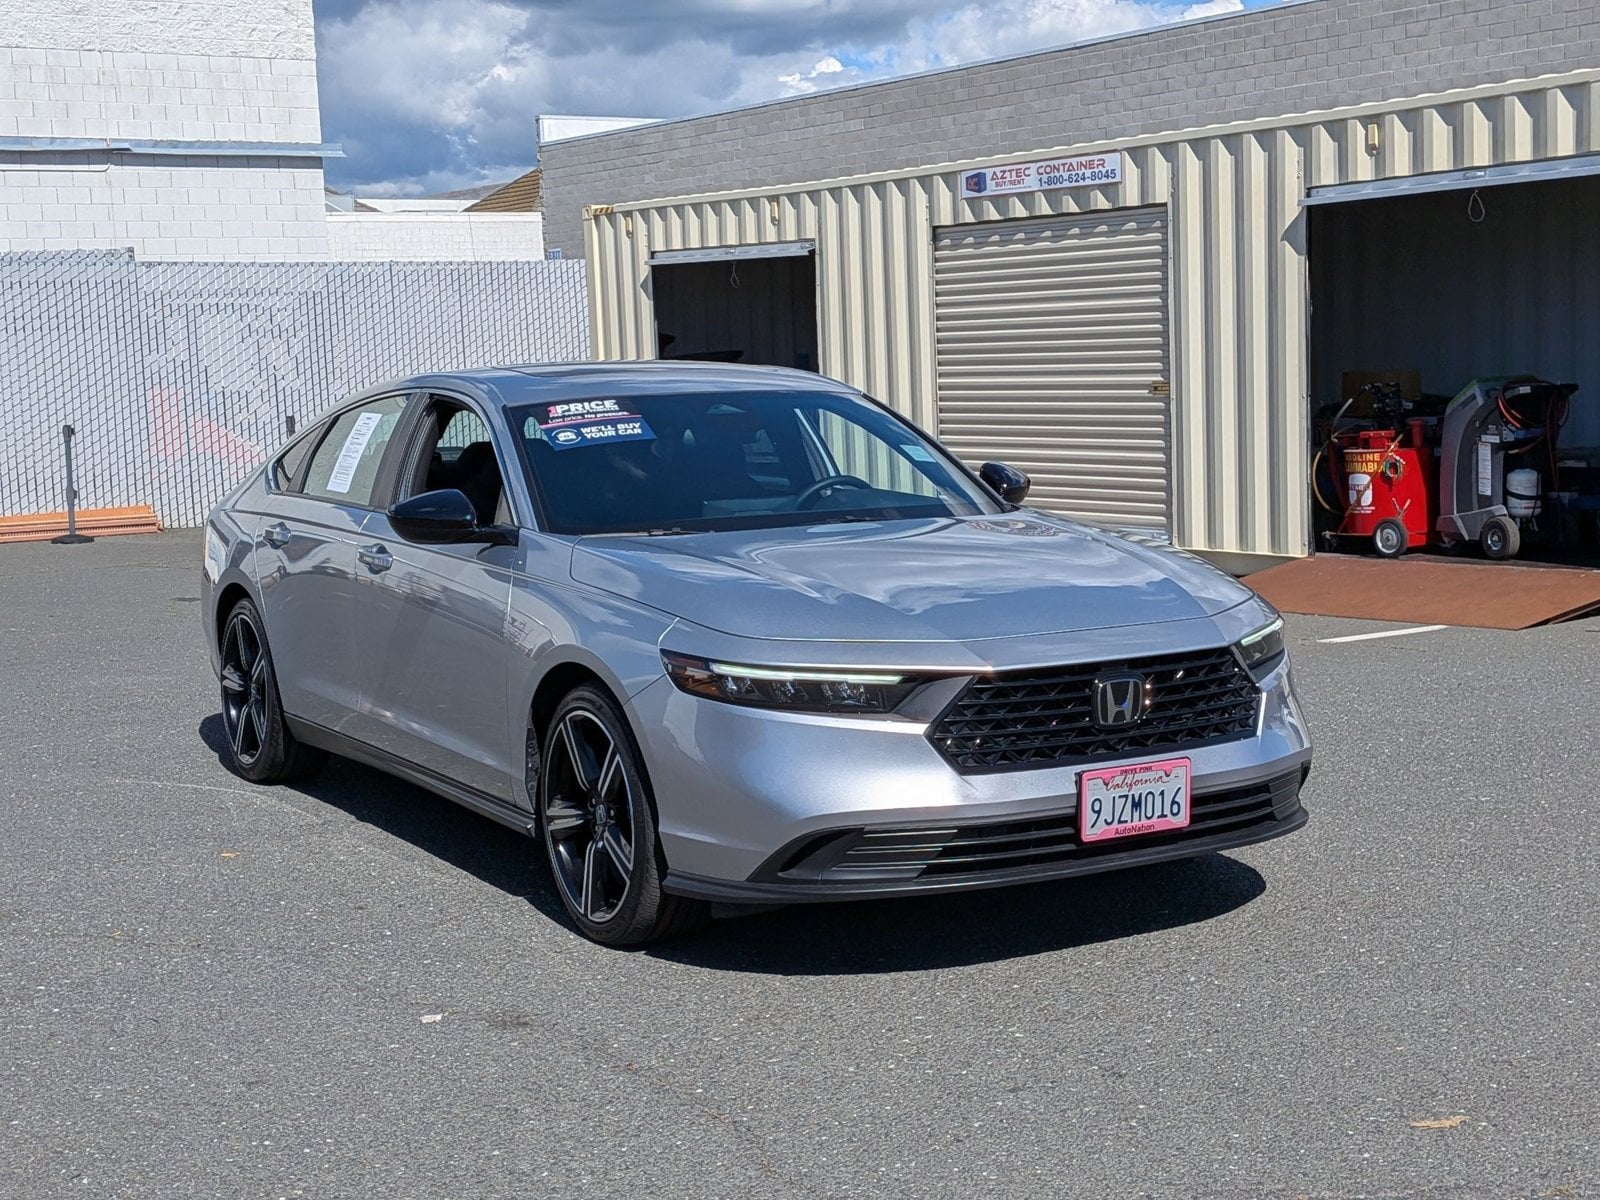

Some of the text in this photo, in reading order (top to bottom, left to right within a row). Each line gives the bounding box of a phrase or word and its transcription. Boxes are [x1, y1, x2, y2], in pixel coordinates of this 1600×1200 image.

[990, 158, 1106, 181] AZTEC CONTAINER
[995, 178, 1025, 188] BUY/RENT
[1038, 169, 1117, 187] 1-800-624-8045
[580, 422, 641, 433] WE'LL BUY
[584, 431, 616, 439] YOUR
[1120, 768, 1138, 776] DRIVE
[1105, 773, 1170, 793] California
[1090, 787, 1181, 829] 9JZM016
[1114, 824, 1155, 836] AutoNation
